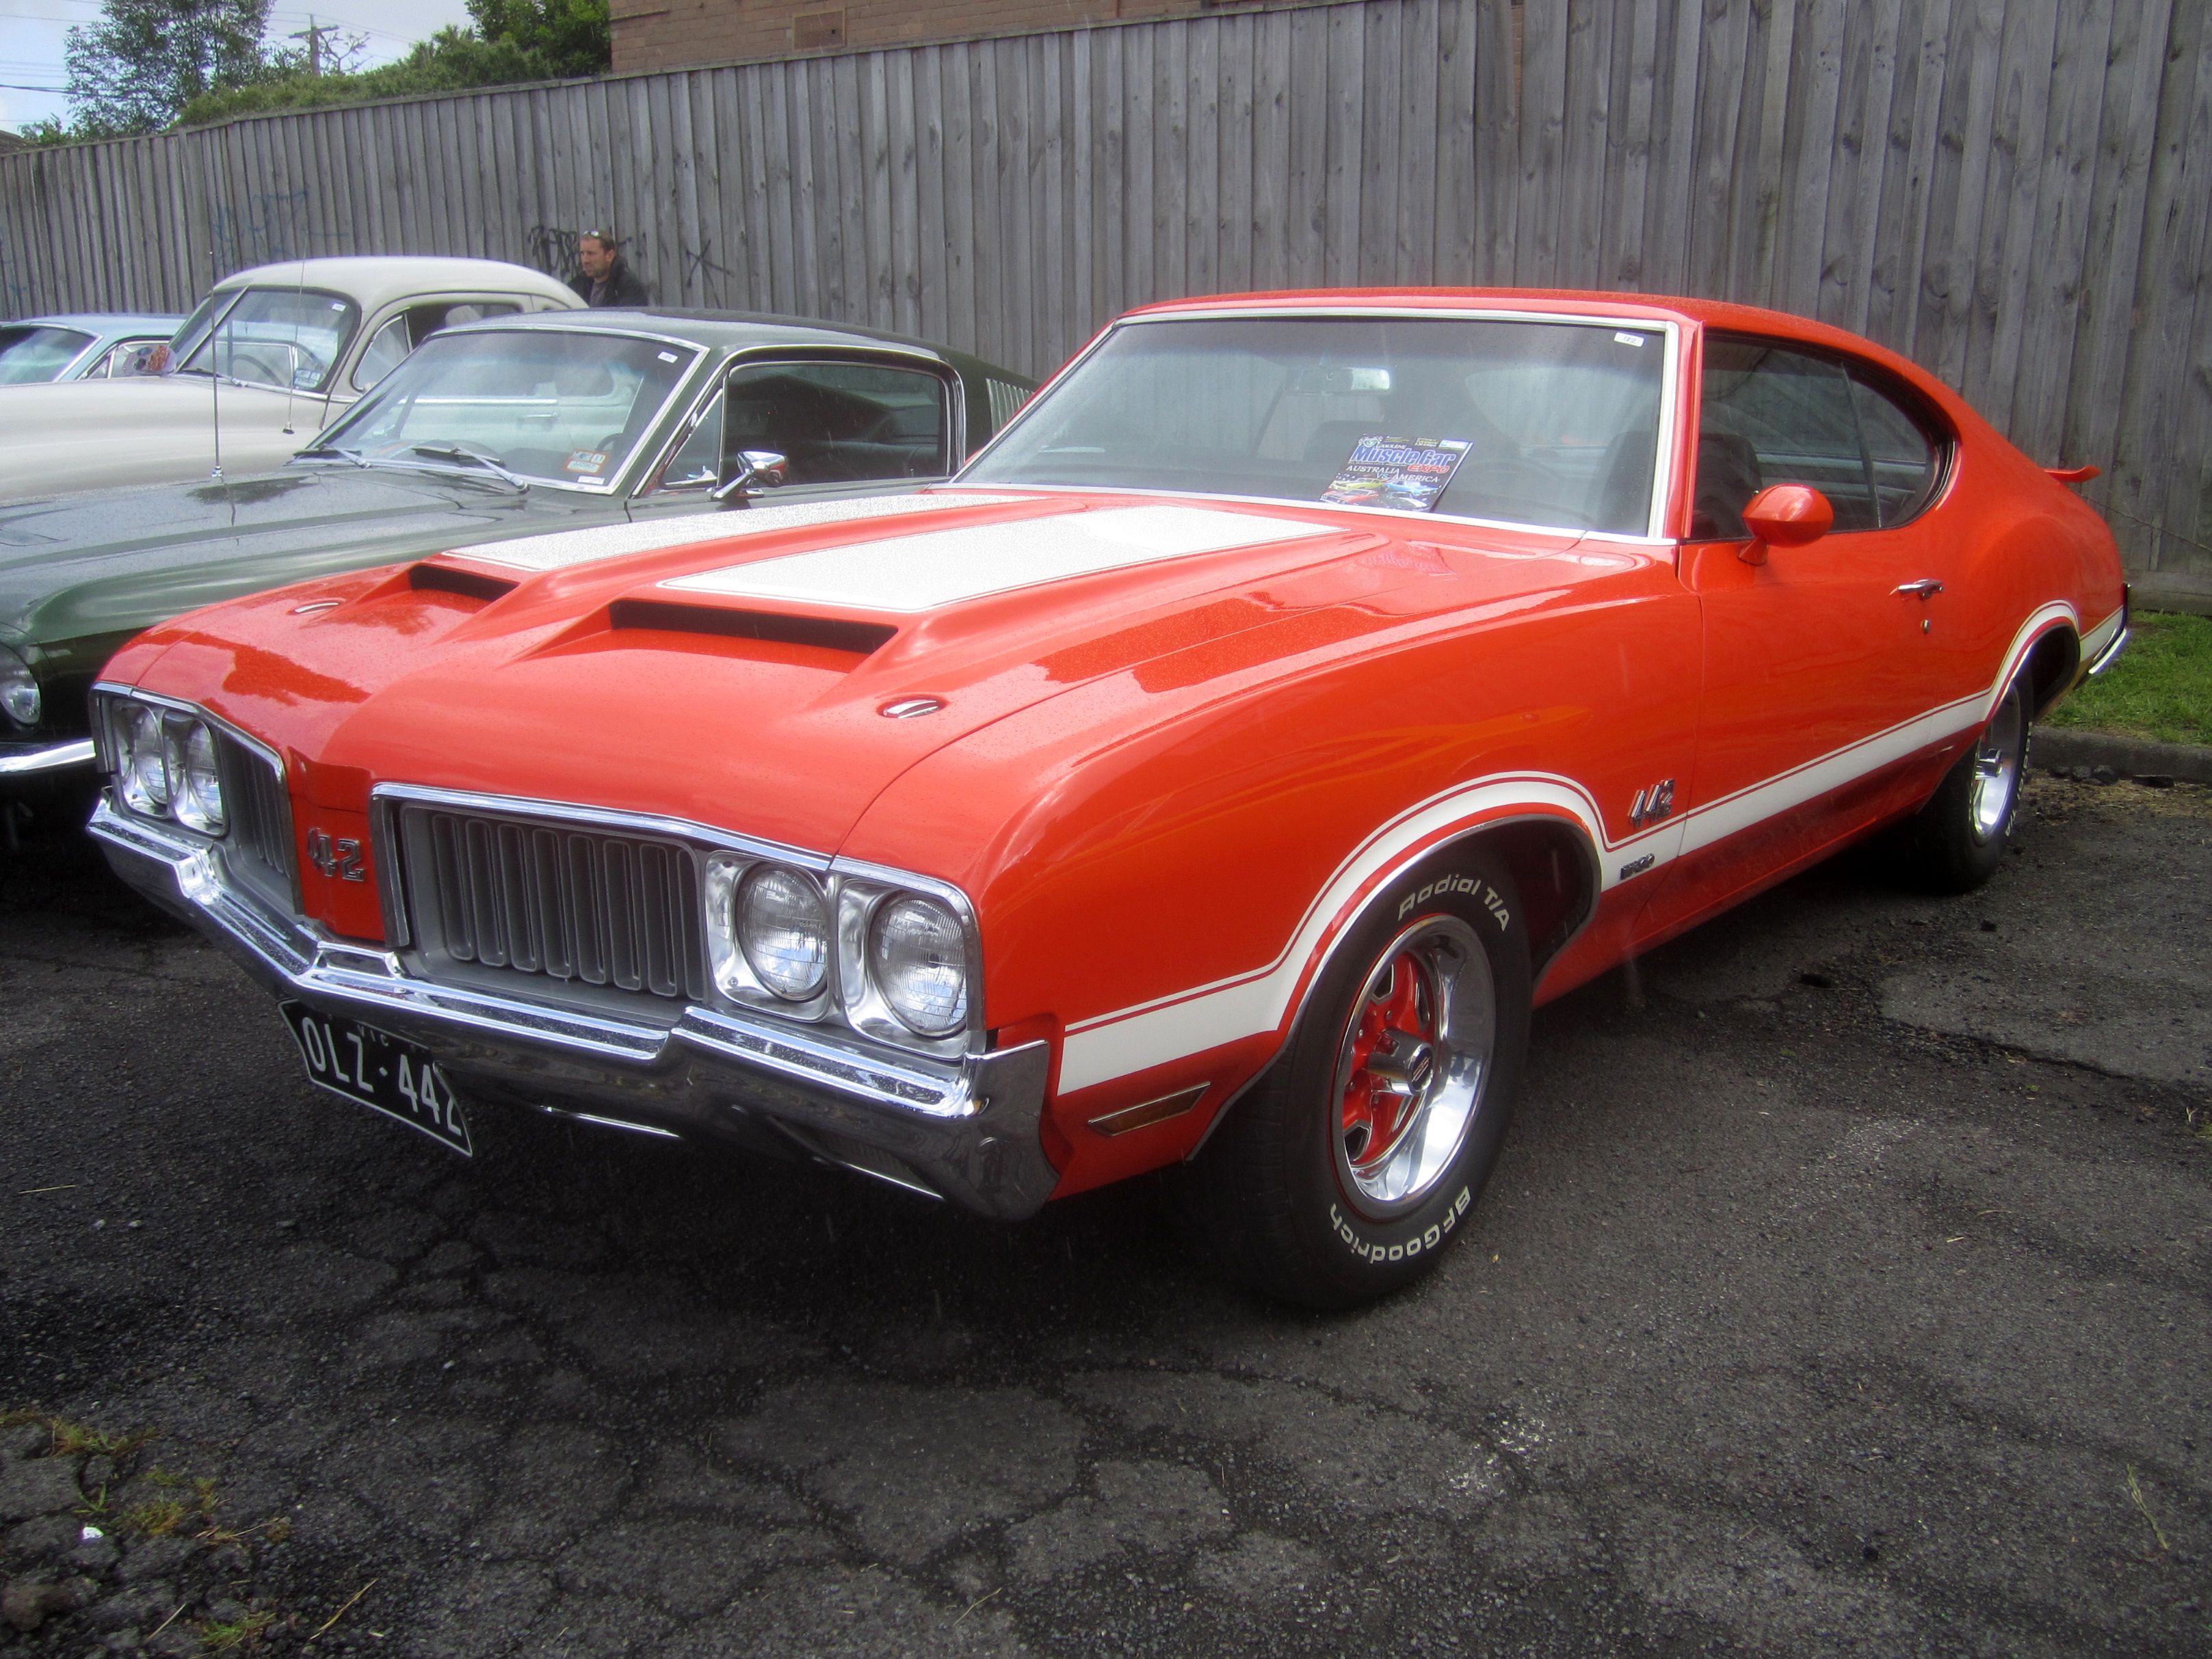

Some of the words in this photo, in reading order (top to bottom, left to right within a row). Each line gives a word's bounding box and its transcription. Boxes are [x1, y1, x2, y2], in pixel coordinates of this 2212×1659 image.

[1349, 445, 1421, 466] Muscle
[1420, 449, 1457, 468] Car
[1345, 465, 1400, 475] AUSTRALIA
[1407, 464, 1451, 474] EXPO
[1392, 473, 1439, 483] AMERICA
[1396, 873, 1482, 923] Radial
[1484, 886, 1512, 933] T/A
[358, 1024, 389, 1048] VIC
